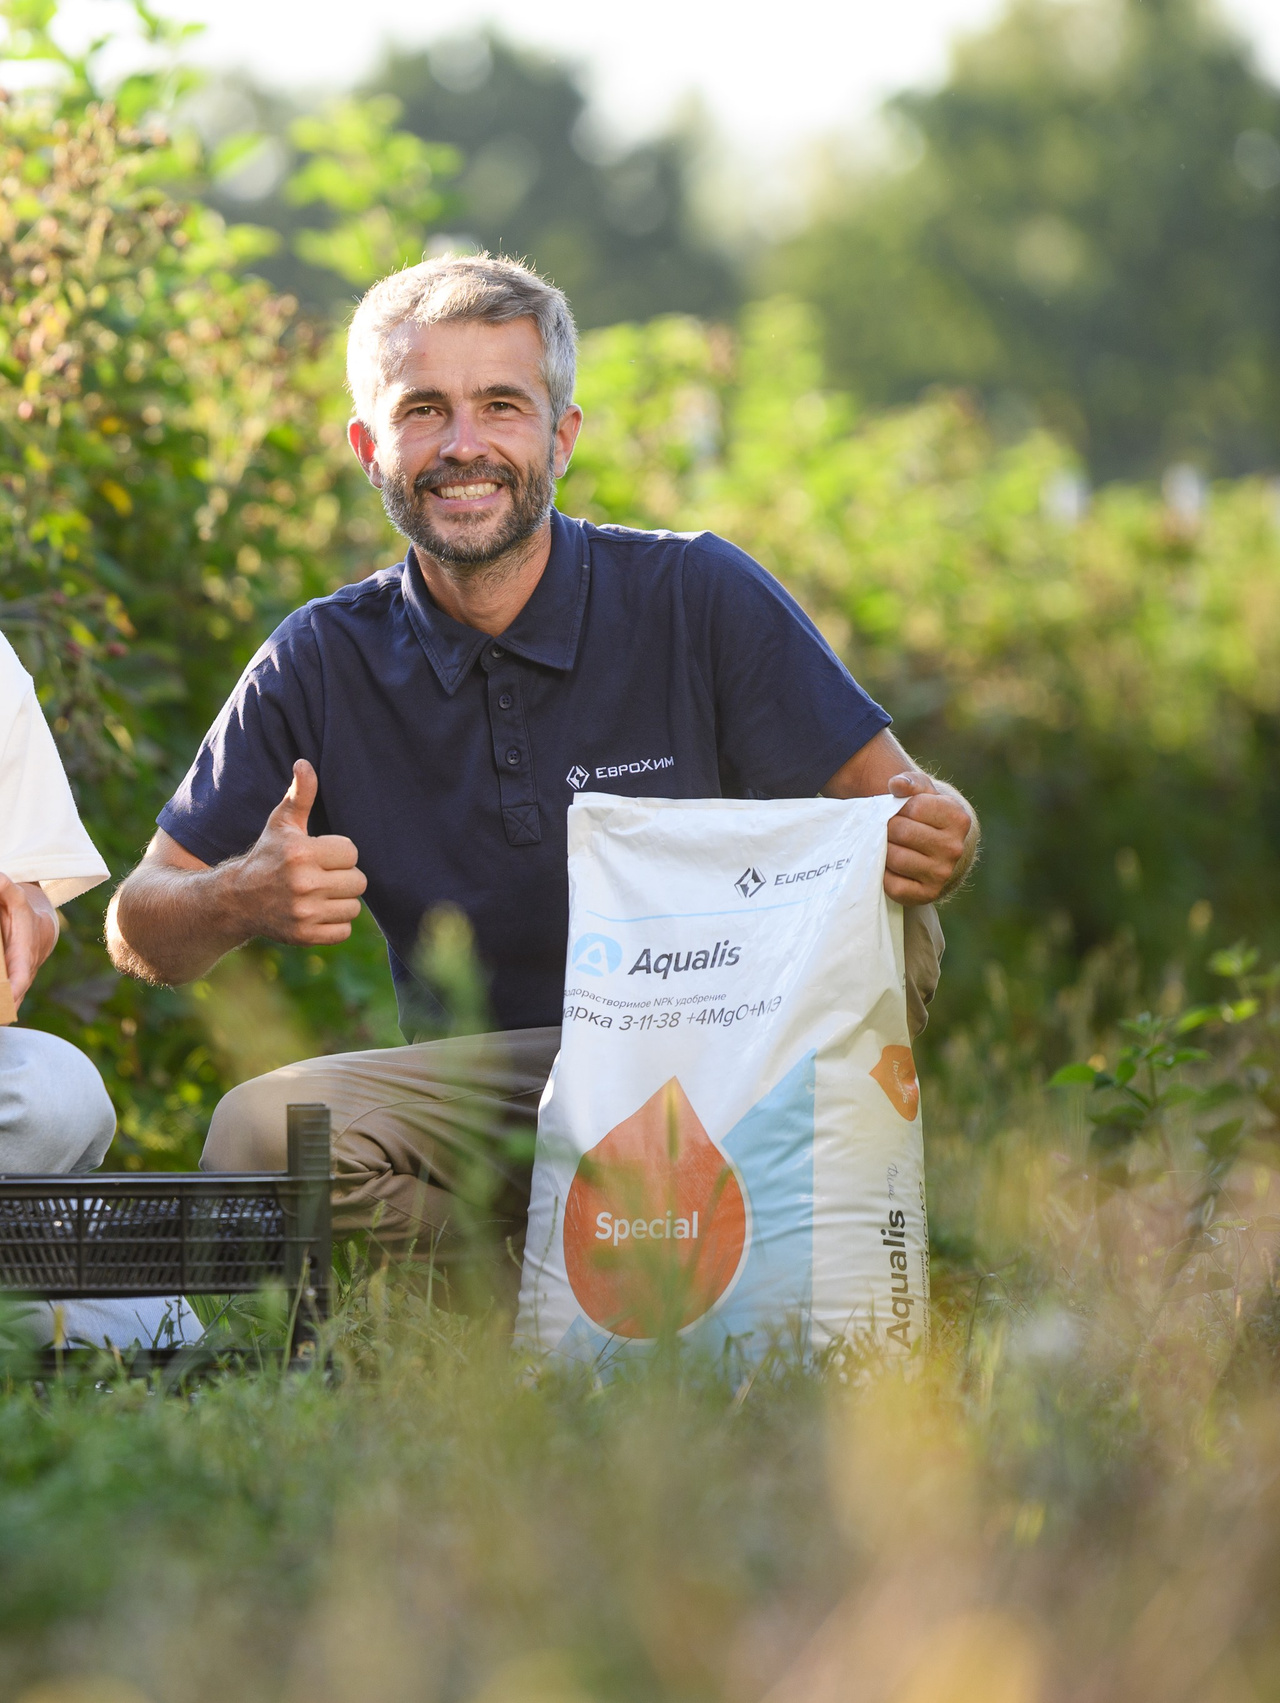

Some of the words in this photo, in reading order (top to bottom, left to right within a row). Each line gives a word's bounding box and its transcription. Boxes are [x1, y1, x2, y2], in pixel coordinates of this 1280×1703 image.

[627, 940, 742, 980] Aqualis
[562, 1005, 614, 1029] арка
[618, 1011, 682, 1031] 3-11-38
[653, 996, 674, 1007] NPK
[675, 993, 728, 1007] удобрение
[594, 1210, 699, 1247] Special
[880, 1209, 914, 1350] Aqualis
